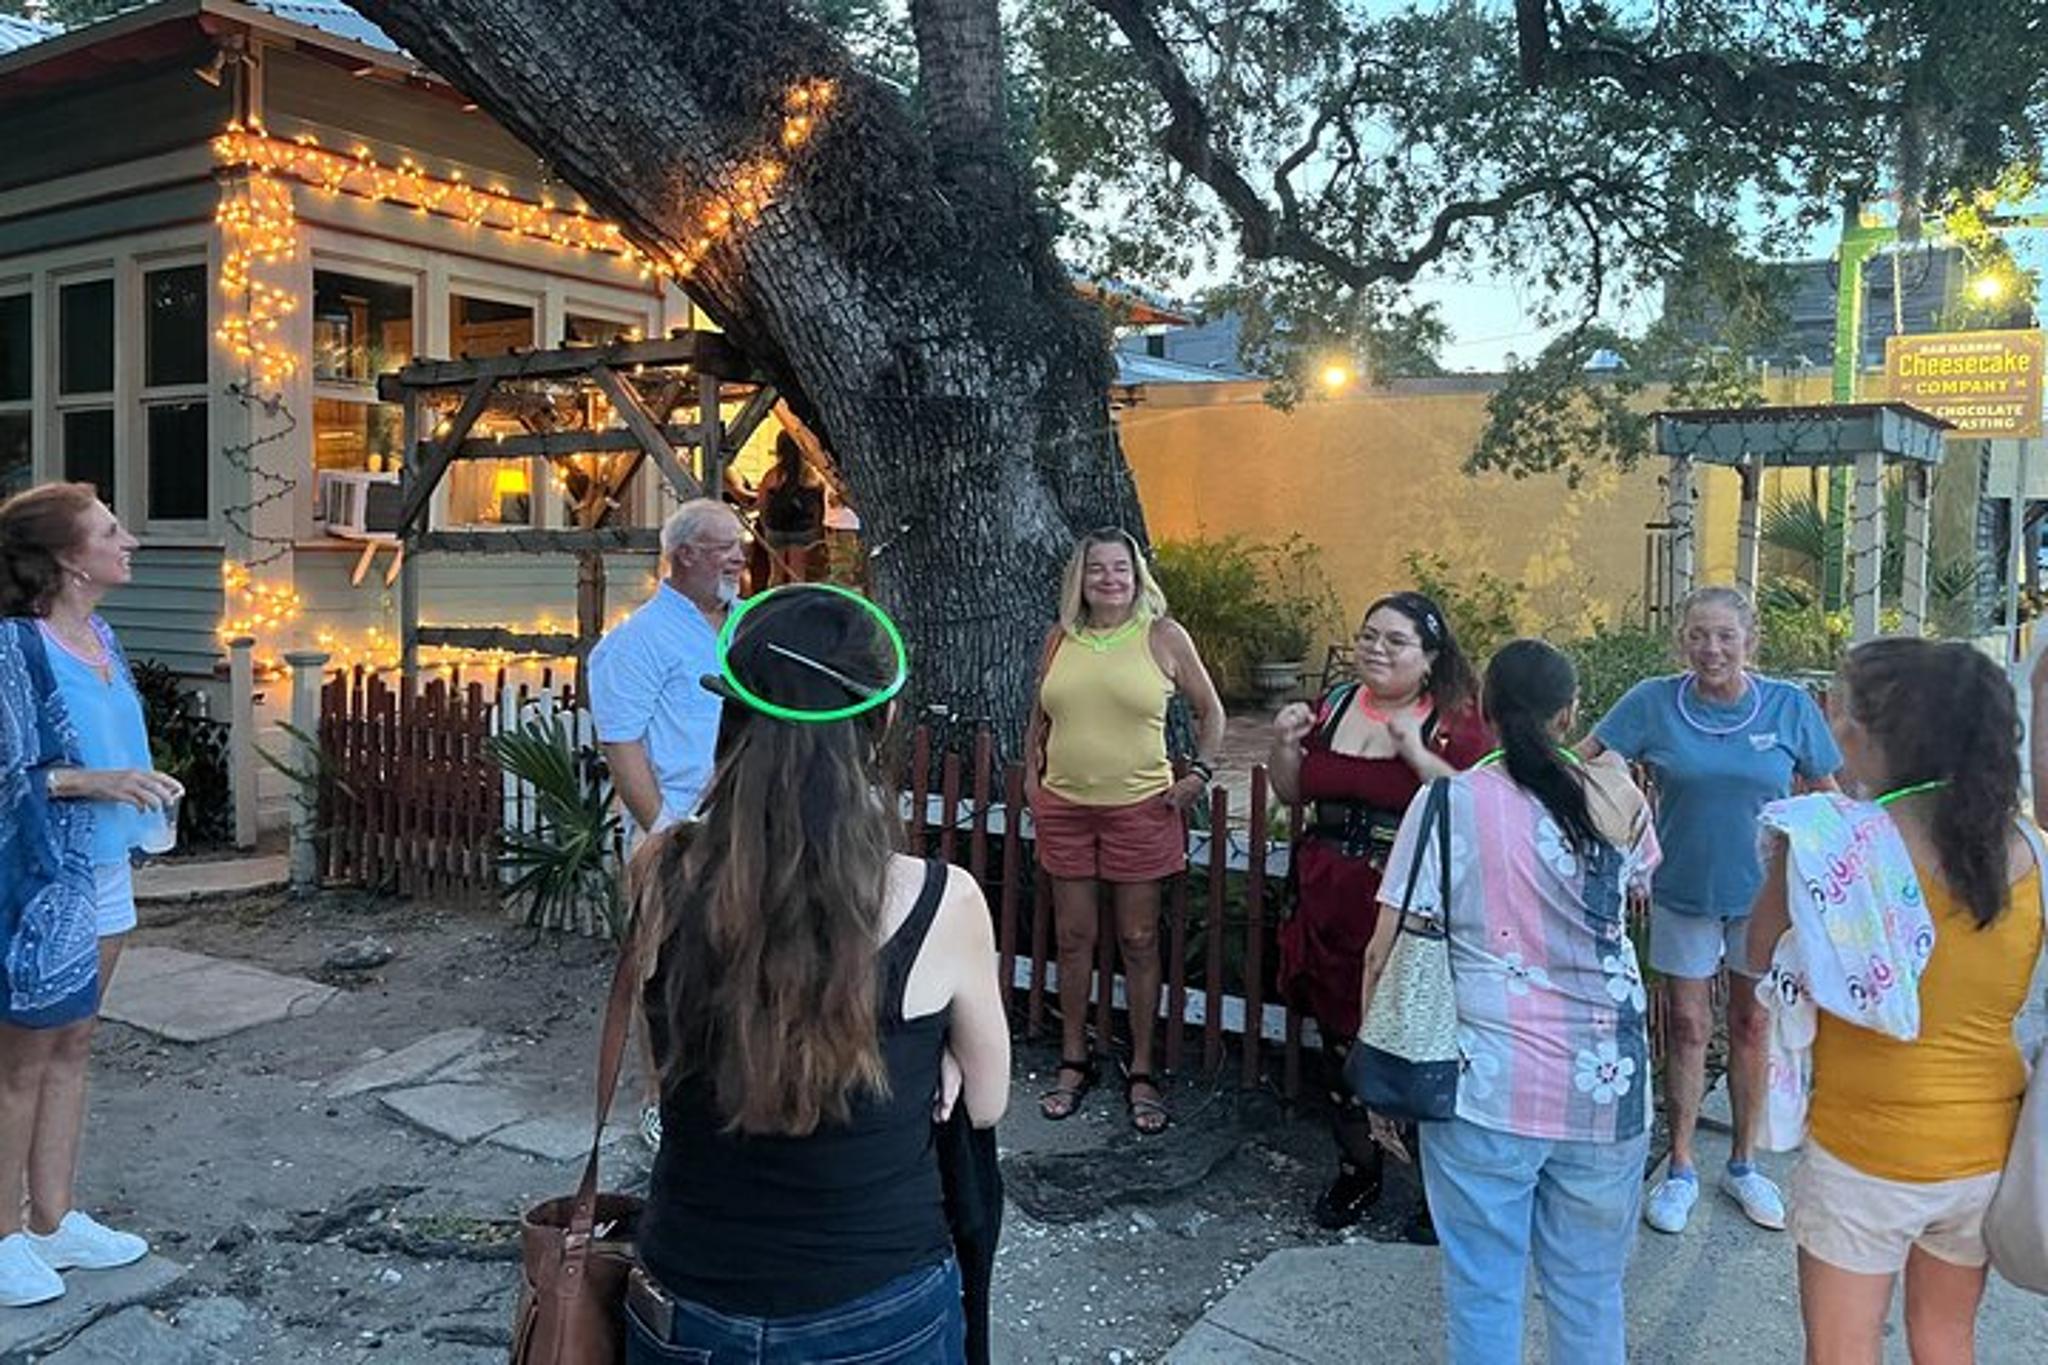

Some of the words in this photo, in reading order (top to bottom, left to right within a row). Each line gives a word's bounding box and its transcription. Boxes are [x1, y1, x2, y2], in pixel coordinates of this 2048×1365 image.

[1899, 349, 2031, 376] Cheesecake
[1916, 379, 2008, 395] COMPANY
[1936, 403, 2024, 417] CHOCOLATE
